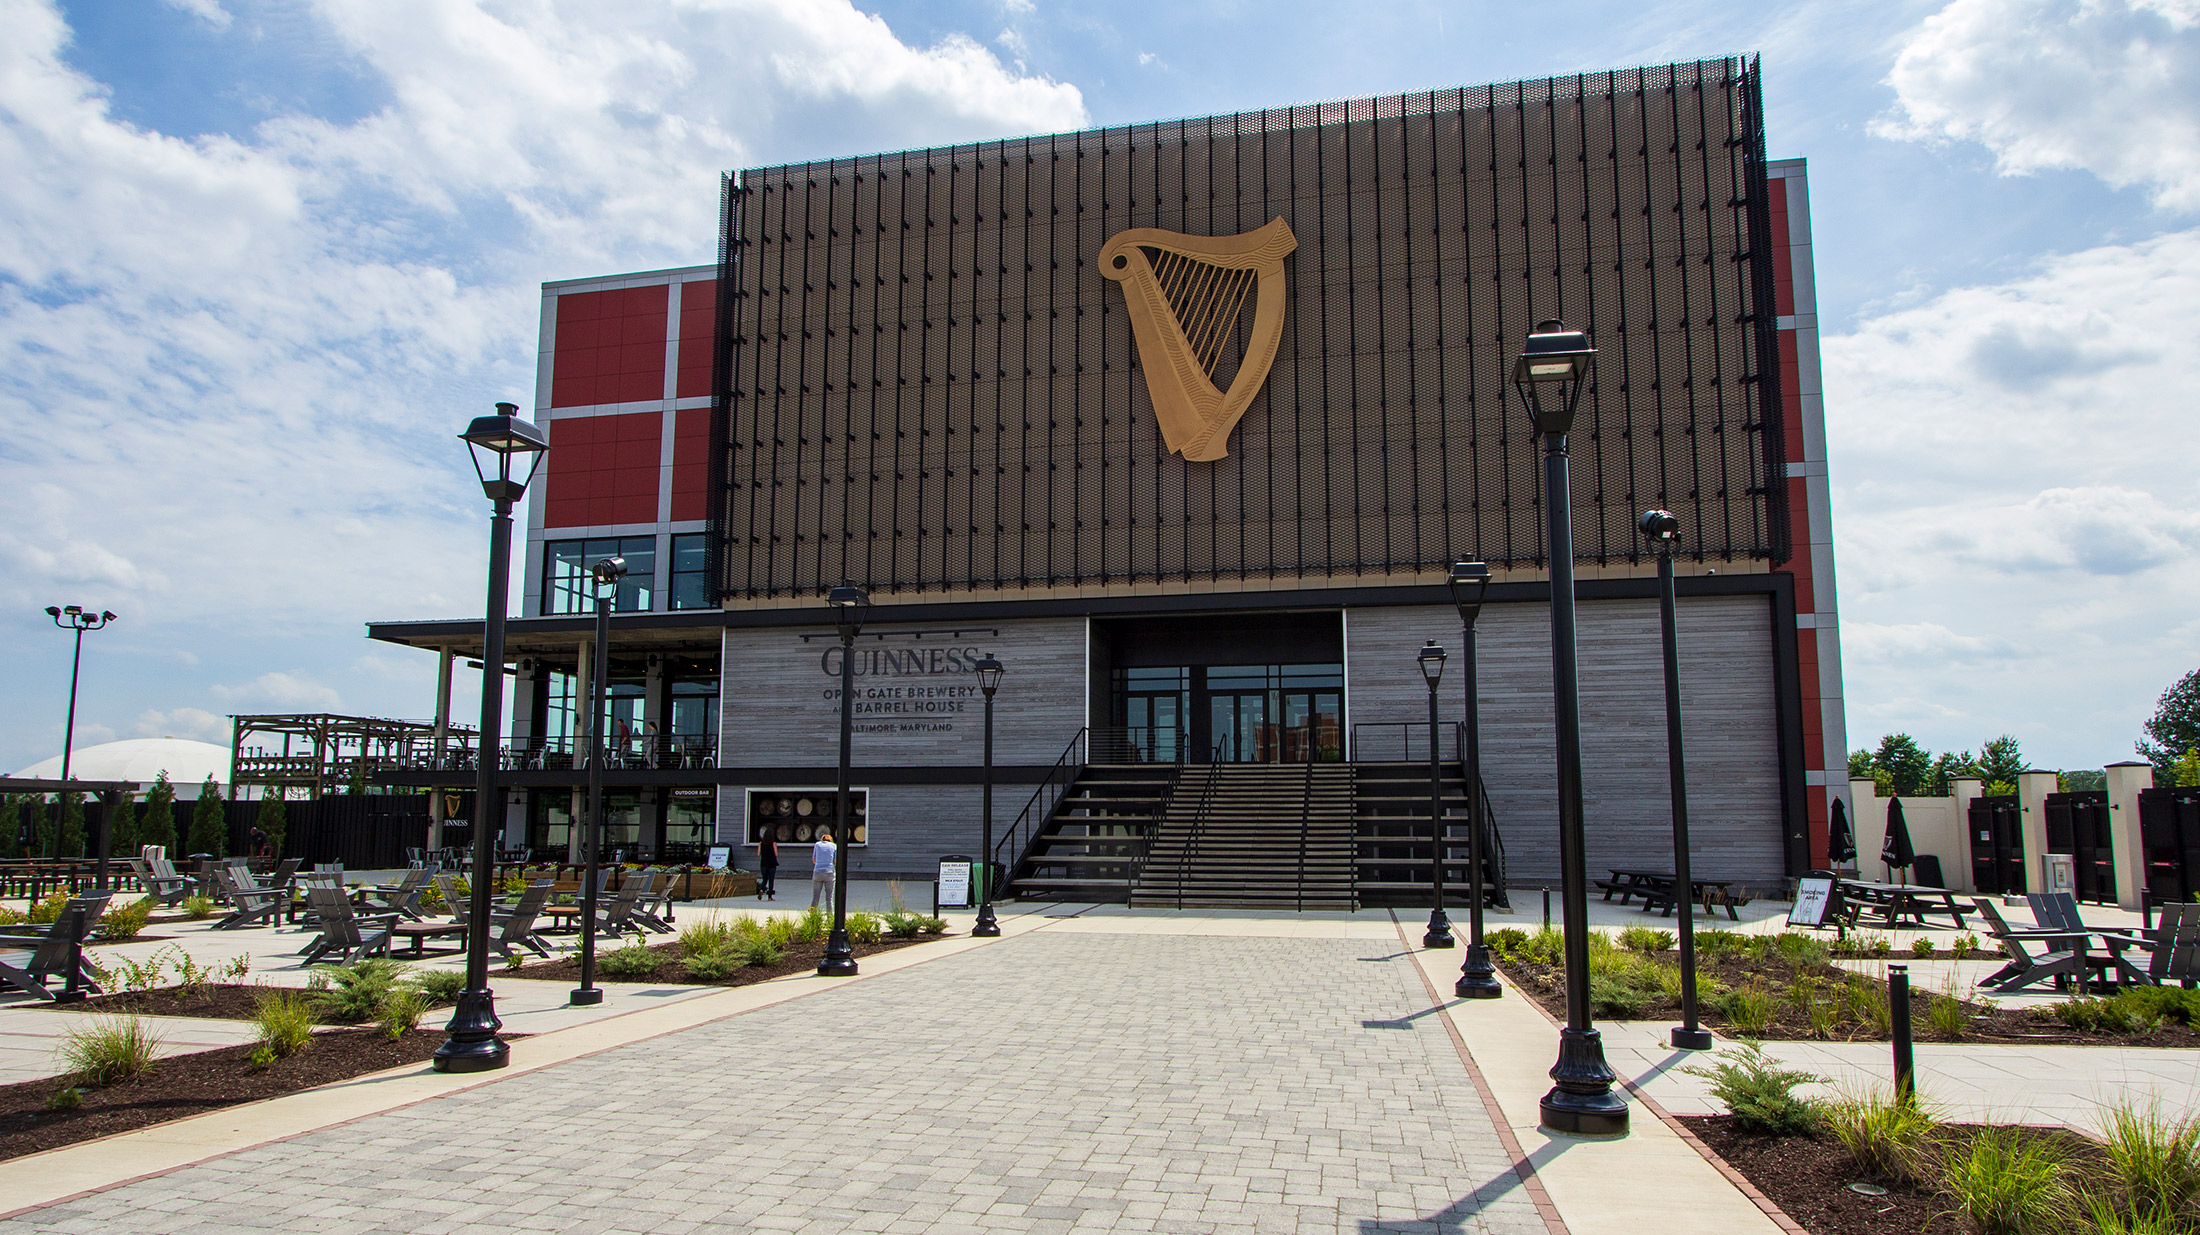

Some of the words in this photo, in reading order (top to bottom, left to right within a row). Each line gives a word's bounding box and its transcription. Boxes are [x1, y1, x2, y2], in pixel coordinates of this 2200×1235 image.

[821, 646, 979, 677] GUINNESS
[823, 688, 861, 700] OPN
[867, 687, 902, 699] GATE
[907, 686, 976, 698] BREWERY
[855, 702, 909, 713] BARREL
[914, 701, 964, 712] HOUSE
[850, 724, 897, 734] ALTIMORE,
[900, 723, 953, 732] MARYLAND
[443, 819, 469, 827] INNESS
